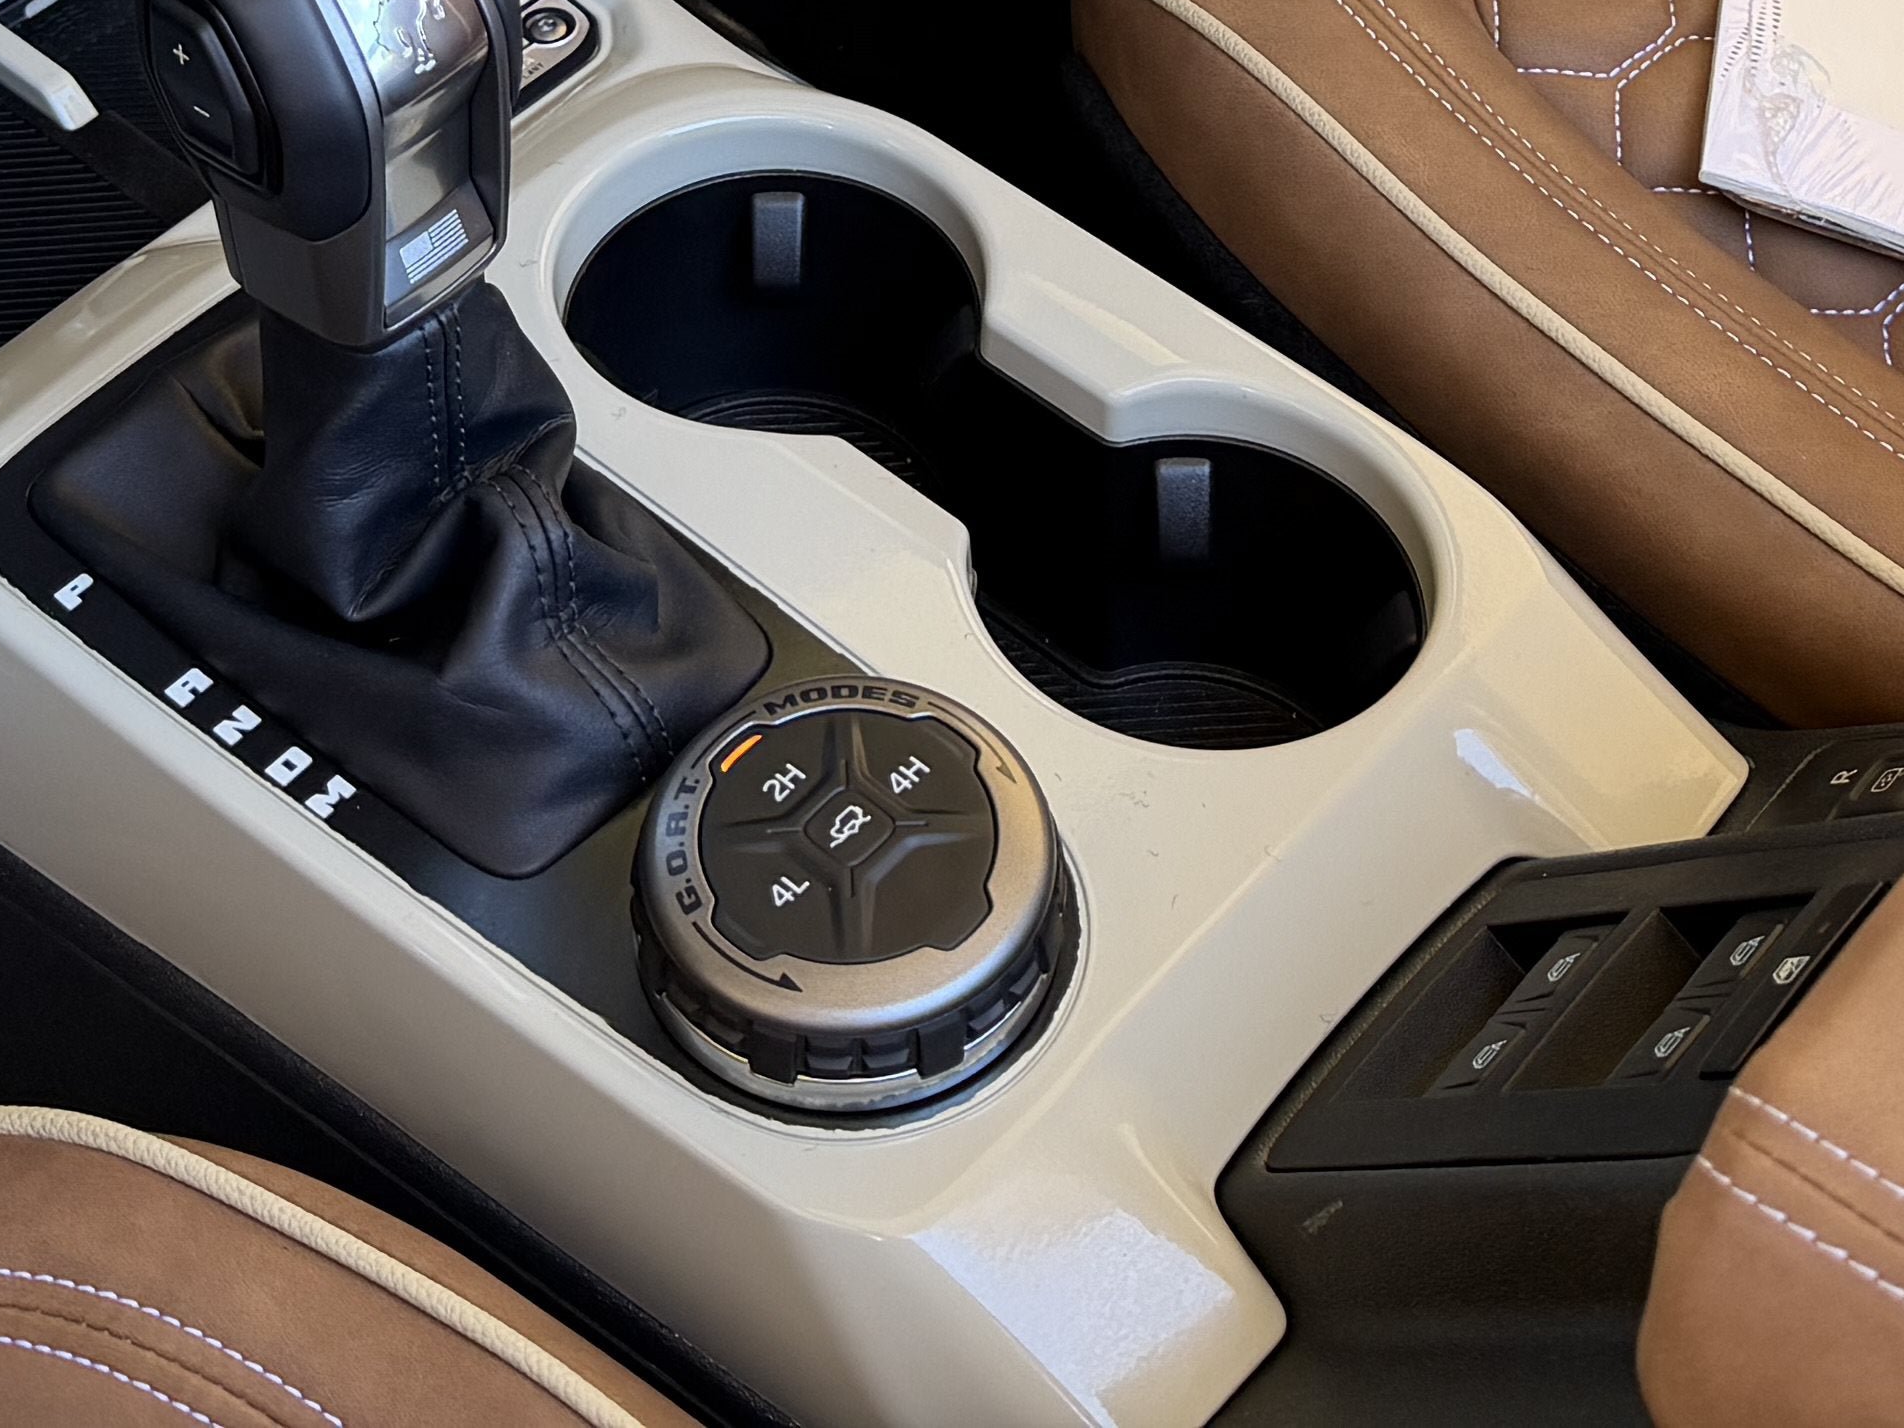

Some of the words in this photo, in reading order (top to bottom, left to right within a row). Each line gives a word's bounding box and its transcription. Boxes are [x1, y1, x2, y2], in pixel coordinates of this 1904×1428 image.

[53, 573, 94, 611] P
[164, 668, 214, 708] R
[213, 705, 262, 745] N
[264, 746, 313, 787] D
[304, 774, 357, 819] M
[763, 684, 920, 714] MODES
[763, 764, 806, 802] 2H
[889, 756, 931, 795] 4H
[1830, 768, 1858, 785] R
[770, 875, 810, 907] 4L
